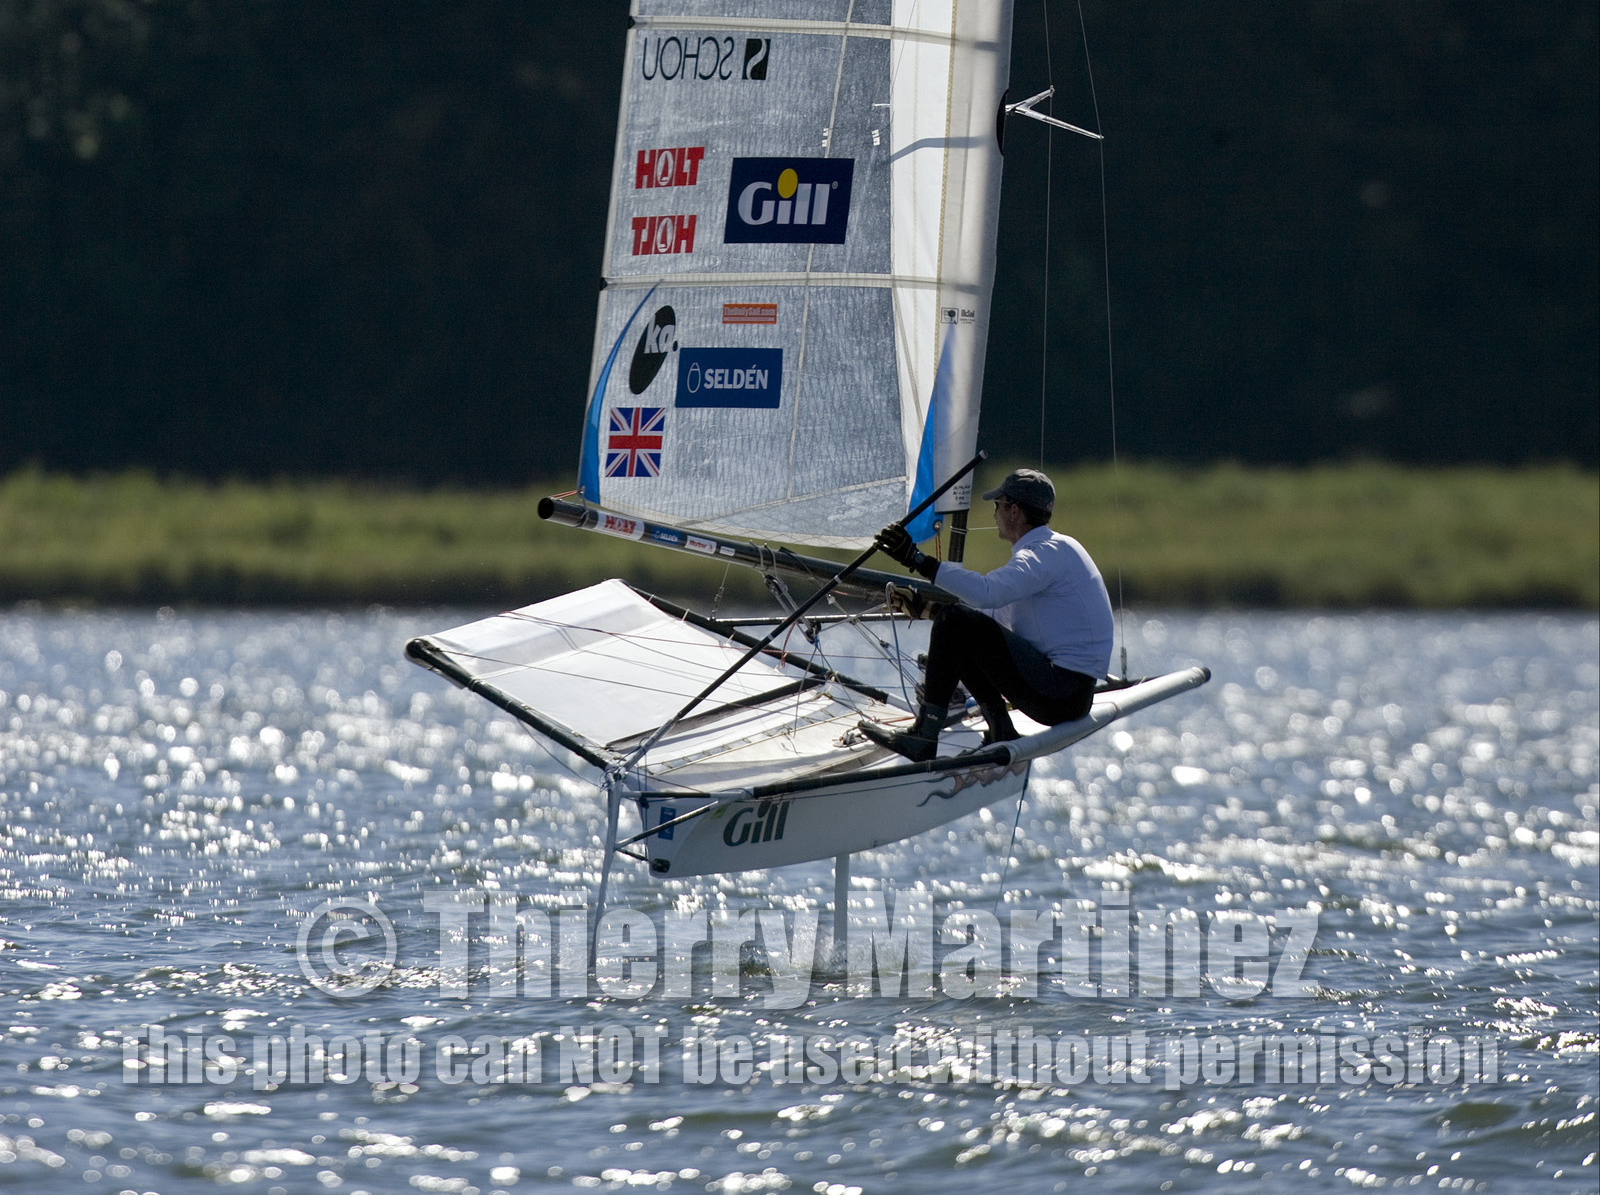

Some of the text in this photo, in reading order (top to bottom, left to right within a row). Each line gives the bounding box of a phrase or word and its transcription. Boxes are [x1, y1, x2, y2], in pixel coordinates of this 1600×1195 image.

[635, 146, 705, 189] HOLT
[737, 168, 831, 226] Gill
[703, 364, 769, 390] SELDÉN
[604, 514, 637, 535] HOLT
[723, 800, 791, 847] Gill
